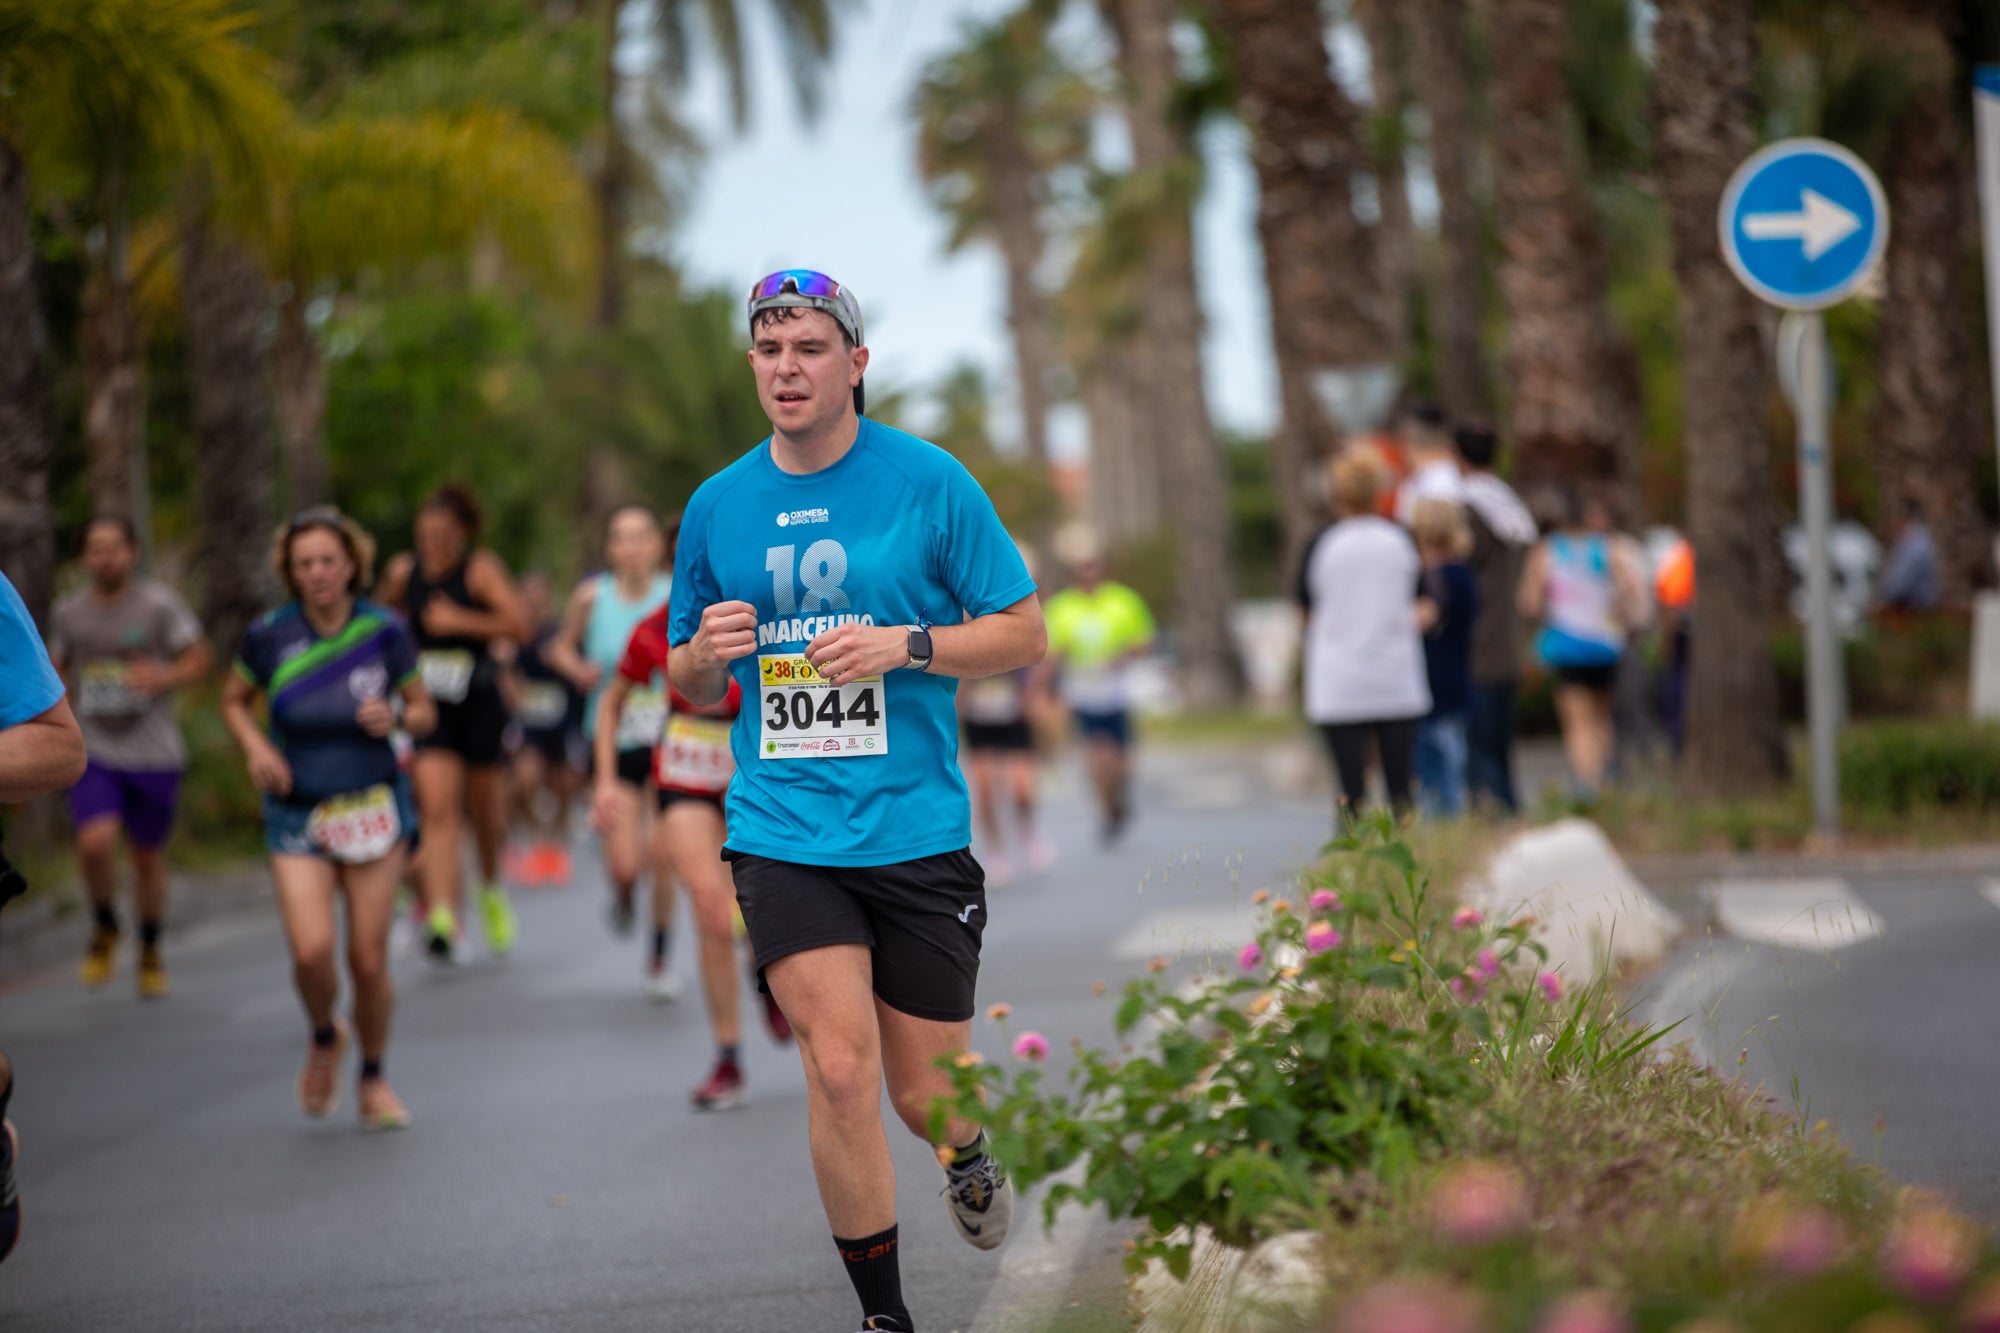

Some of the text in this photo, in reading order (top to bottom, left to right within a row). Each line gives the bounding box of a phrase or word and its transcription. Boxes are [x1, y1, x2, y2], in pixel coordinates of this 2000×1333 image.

[790, 507, 829, 519] OXIMESA
[765, 539, 850, 616] 18
[774, 661, 791, 678] 38
[766, 688, 880, 731] 3044
